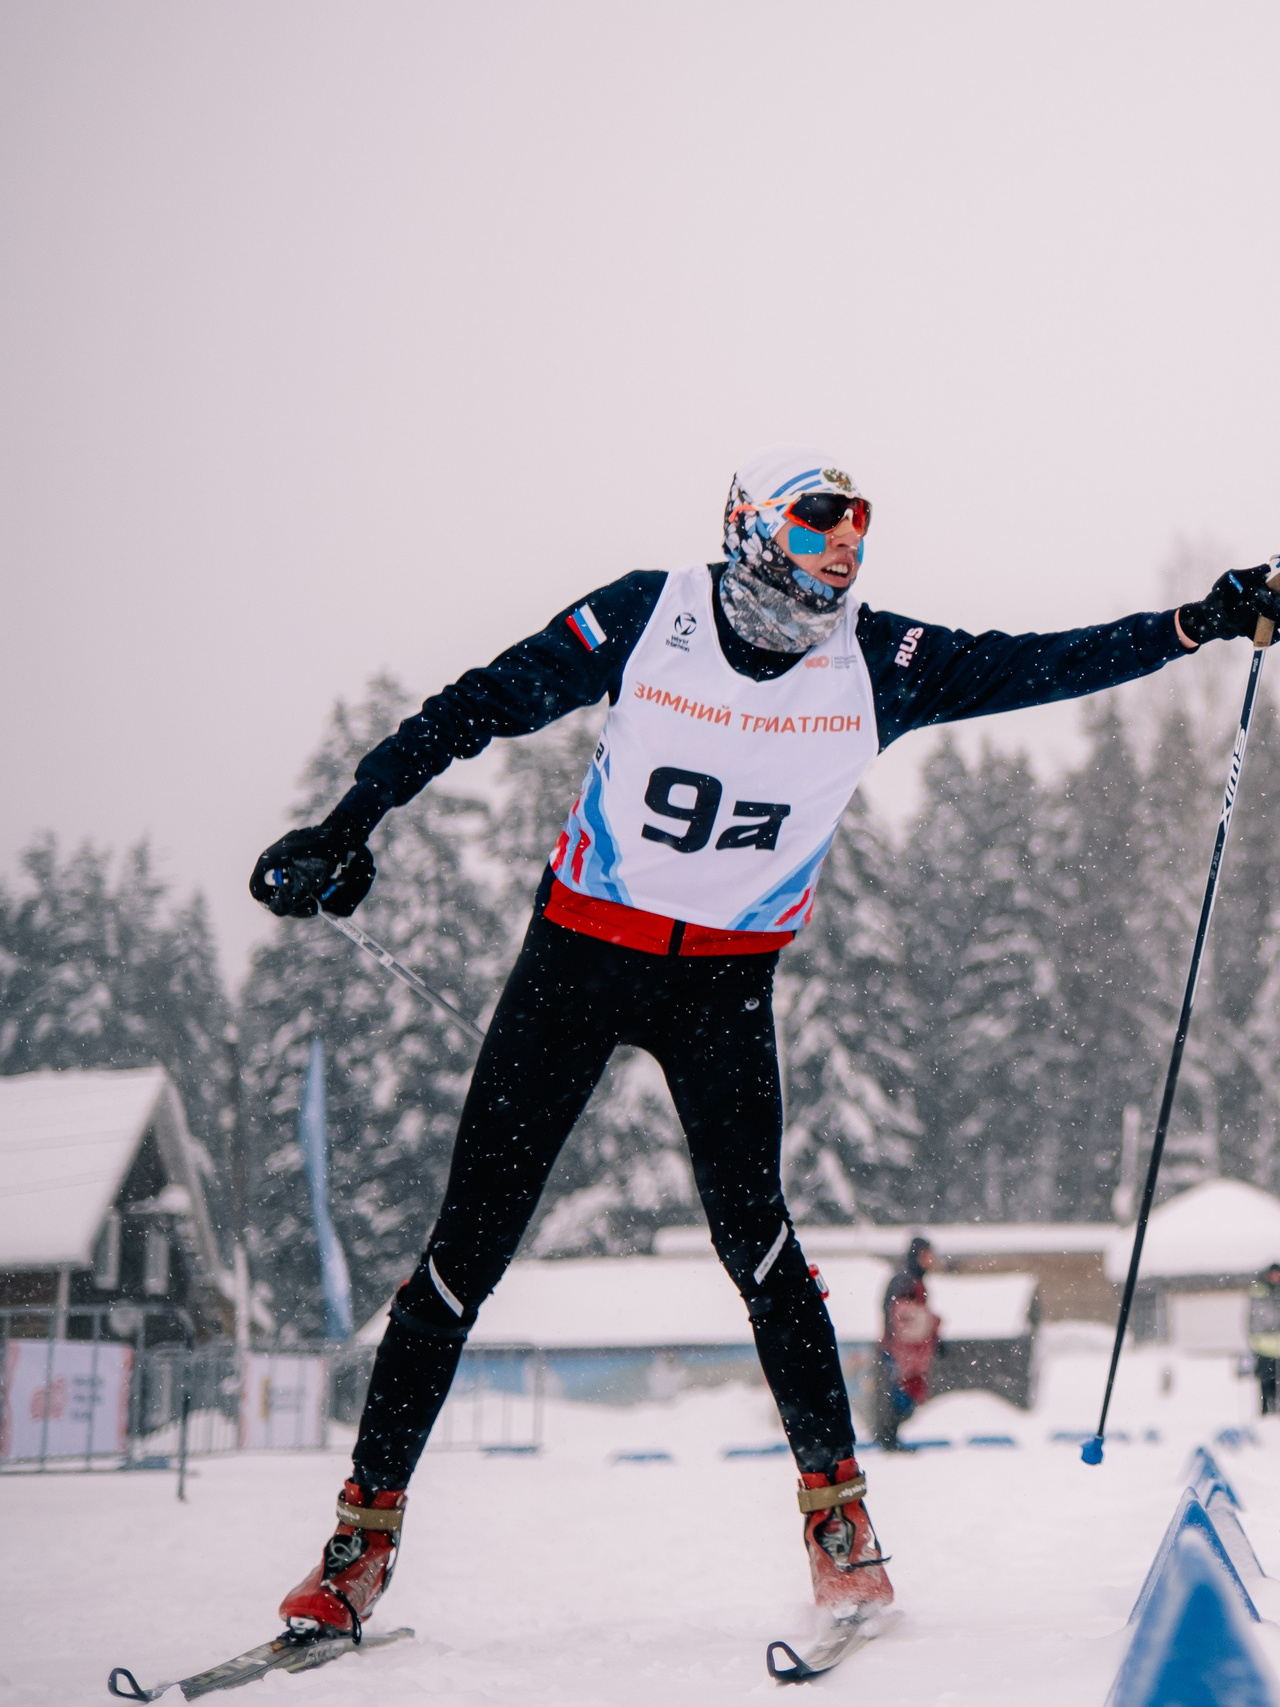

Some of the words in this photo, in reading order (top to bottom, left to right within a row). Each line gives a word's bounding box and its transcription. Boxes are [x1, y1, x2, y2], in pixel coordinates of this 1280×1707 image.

[894, 627, 924, 668] RUS
[634, 681, 732, 727] ЗИМНИЙ
[740, 713, 861, 733] ТРИАТЛОН
[641, 766, 791, 854] 9a
